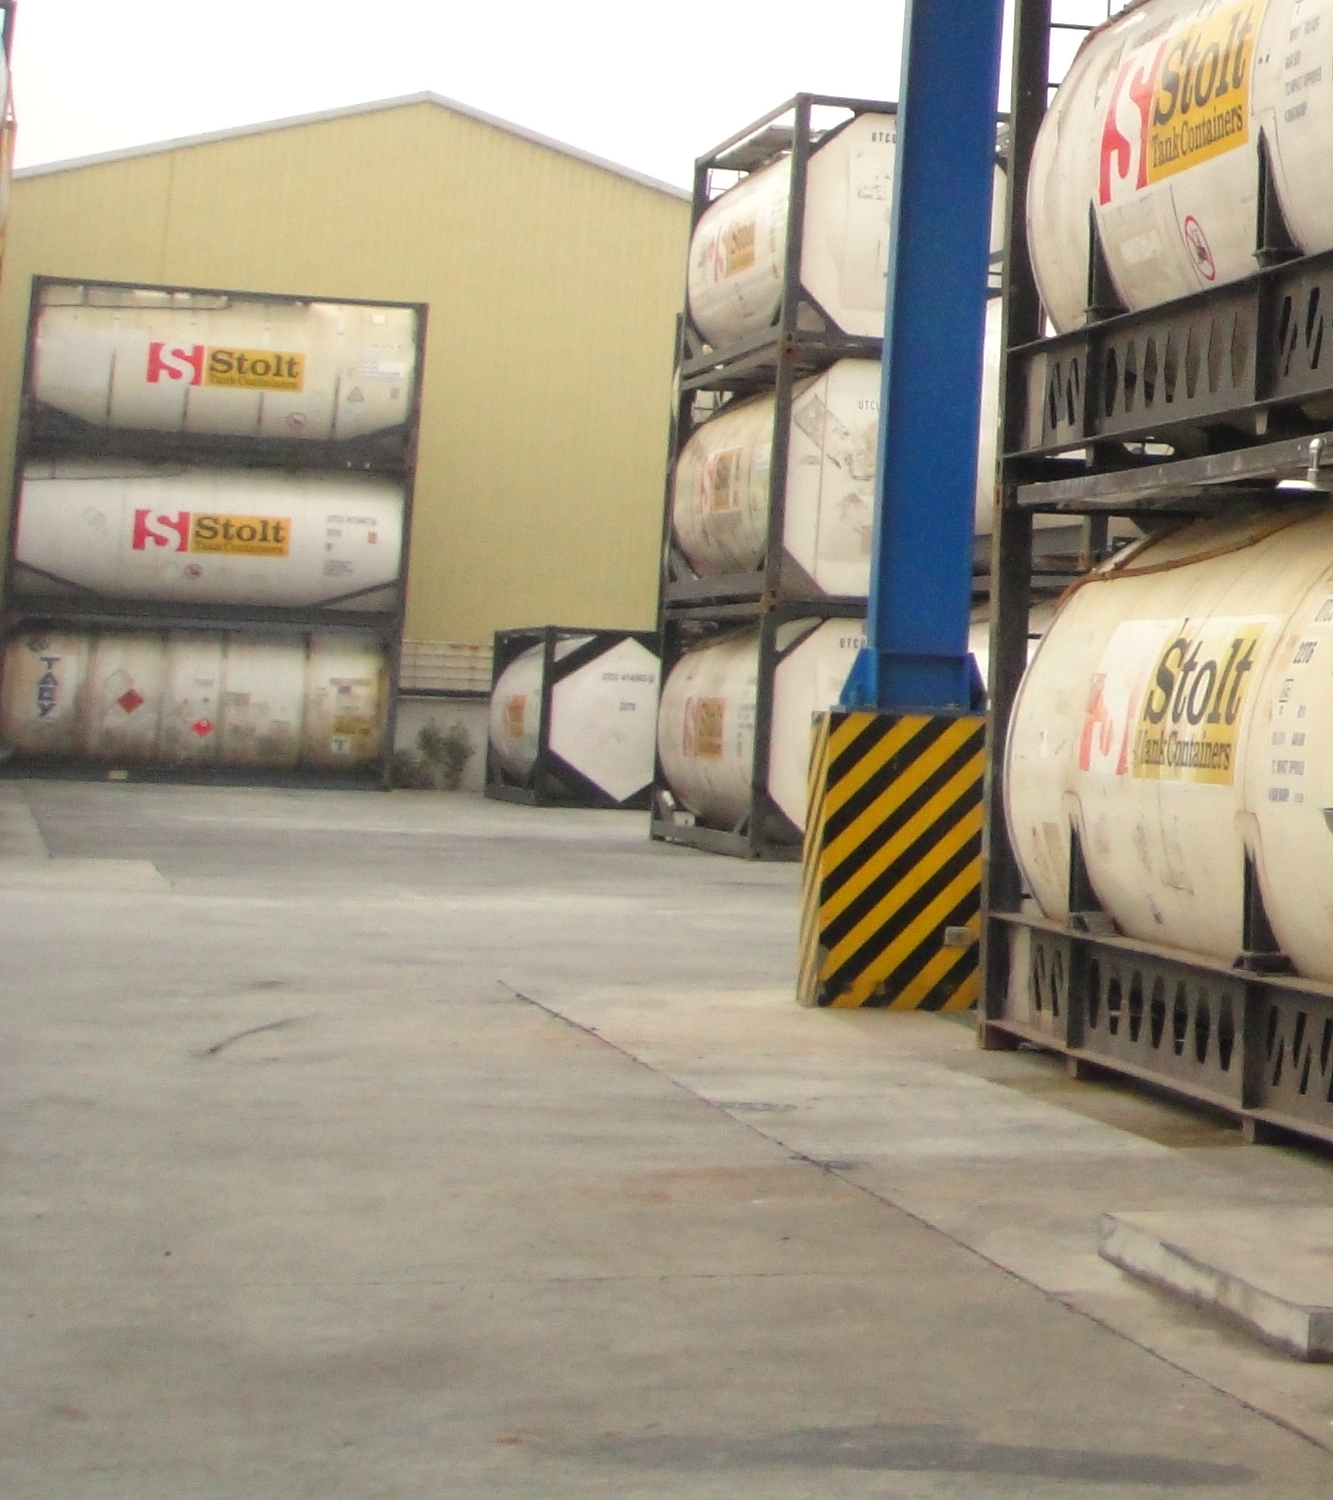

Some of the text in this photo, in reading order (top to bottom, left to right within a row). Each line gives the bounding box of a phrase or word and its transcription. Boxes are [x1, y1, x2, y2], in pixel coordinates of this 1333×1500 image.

[1153, 5, 1255, 127] Stolt
[1152, 127, 1180, 168] Tank
[1180, 104, 1243, 157] Containers
[209, 349, 300, 379] Stolt
[859, 400, 879, 410] UTC
[195, 516, 286, 543] Stolt
[1143, 637, 1257, 726] Stolt
[1166, 729, 1233, 771] Containers
